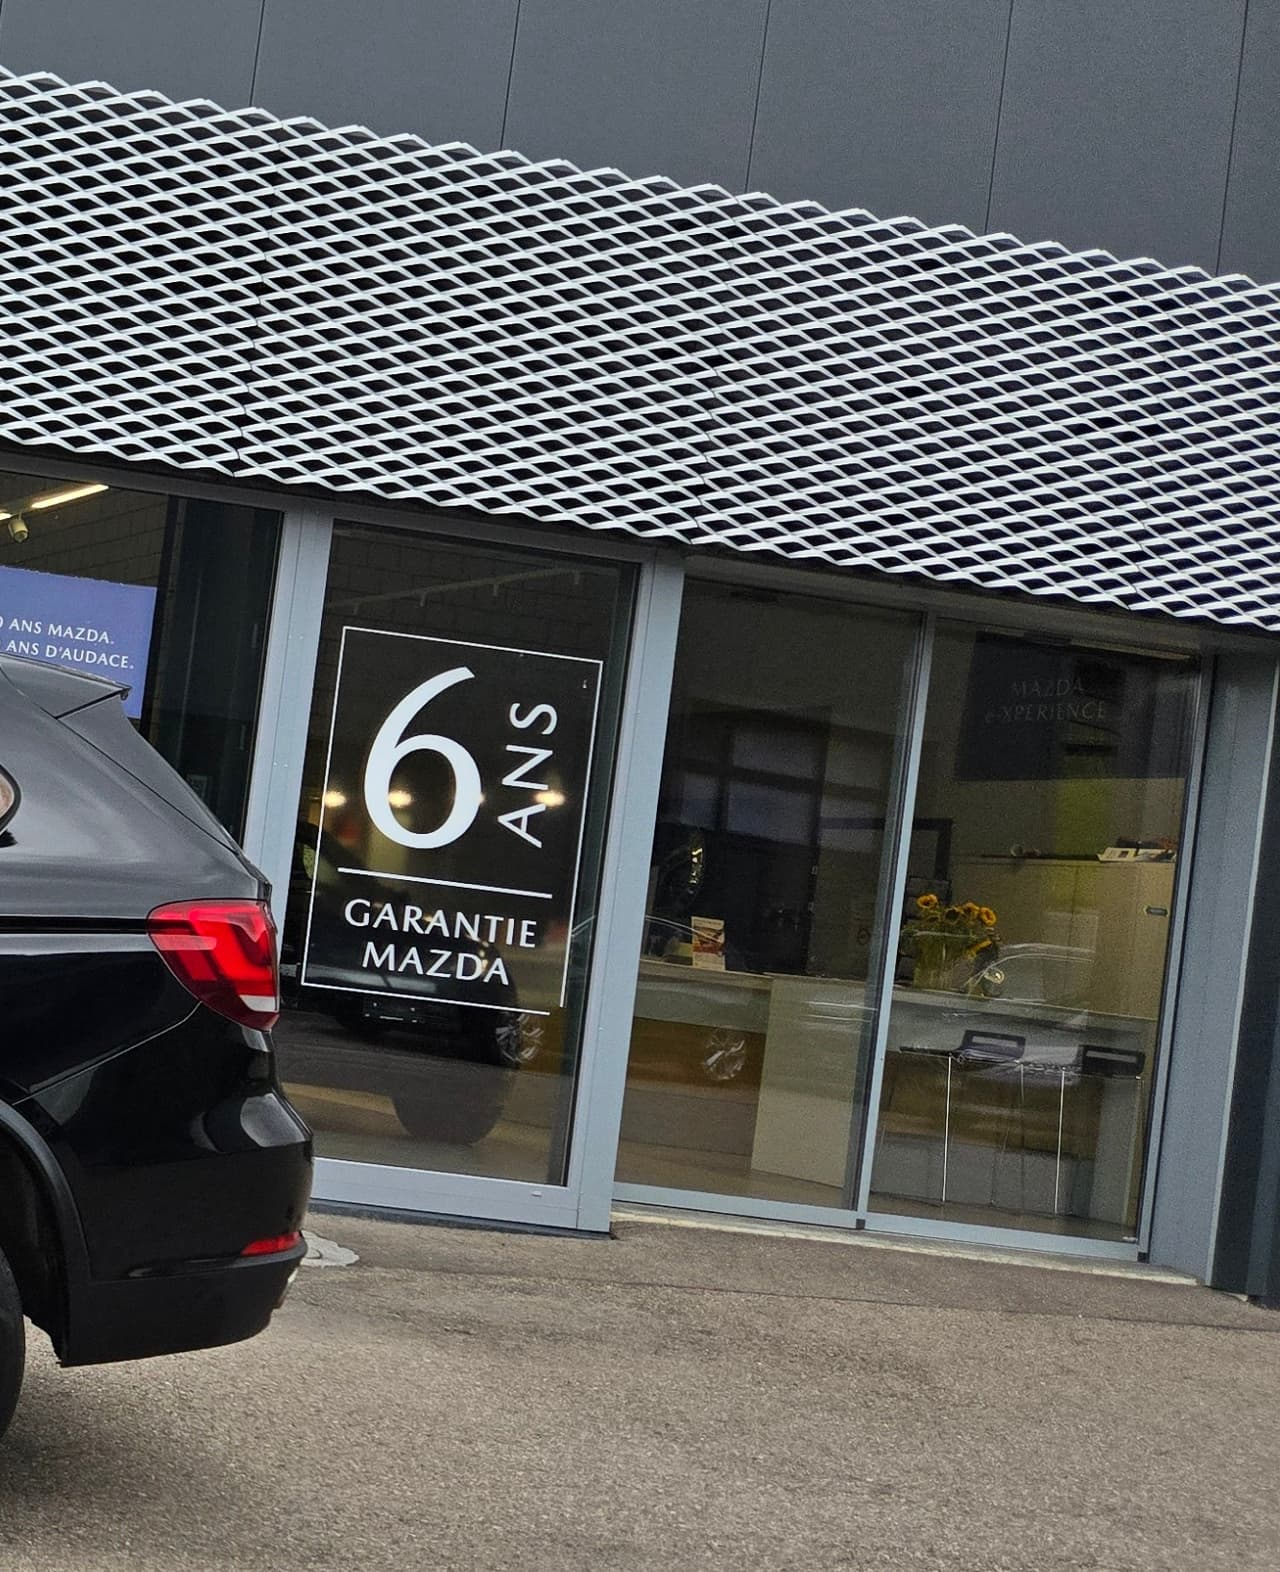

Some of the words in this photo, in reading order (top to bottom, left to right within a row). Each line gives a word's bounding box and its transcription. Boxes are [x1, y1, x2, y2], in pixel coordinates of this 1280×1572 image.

[6, 639, 40, 656] ANS
[46, 645, 134, 669] D'AUDACE.
[8, 617, 43, 634] ANS
[48, 624, 115, 645] MAZDA.
[363, 666, 482, 849] 6
[497, 702, 558, 848] ANS
[344, 898, 537, 948] GARANTIE
[361, 941, 510, 986] MAZDA
